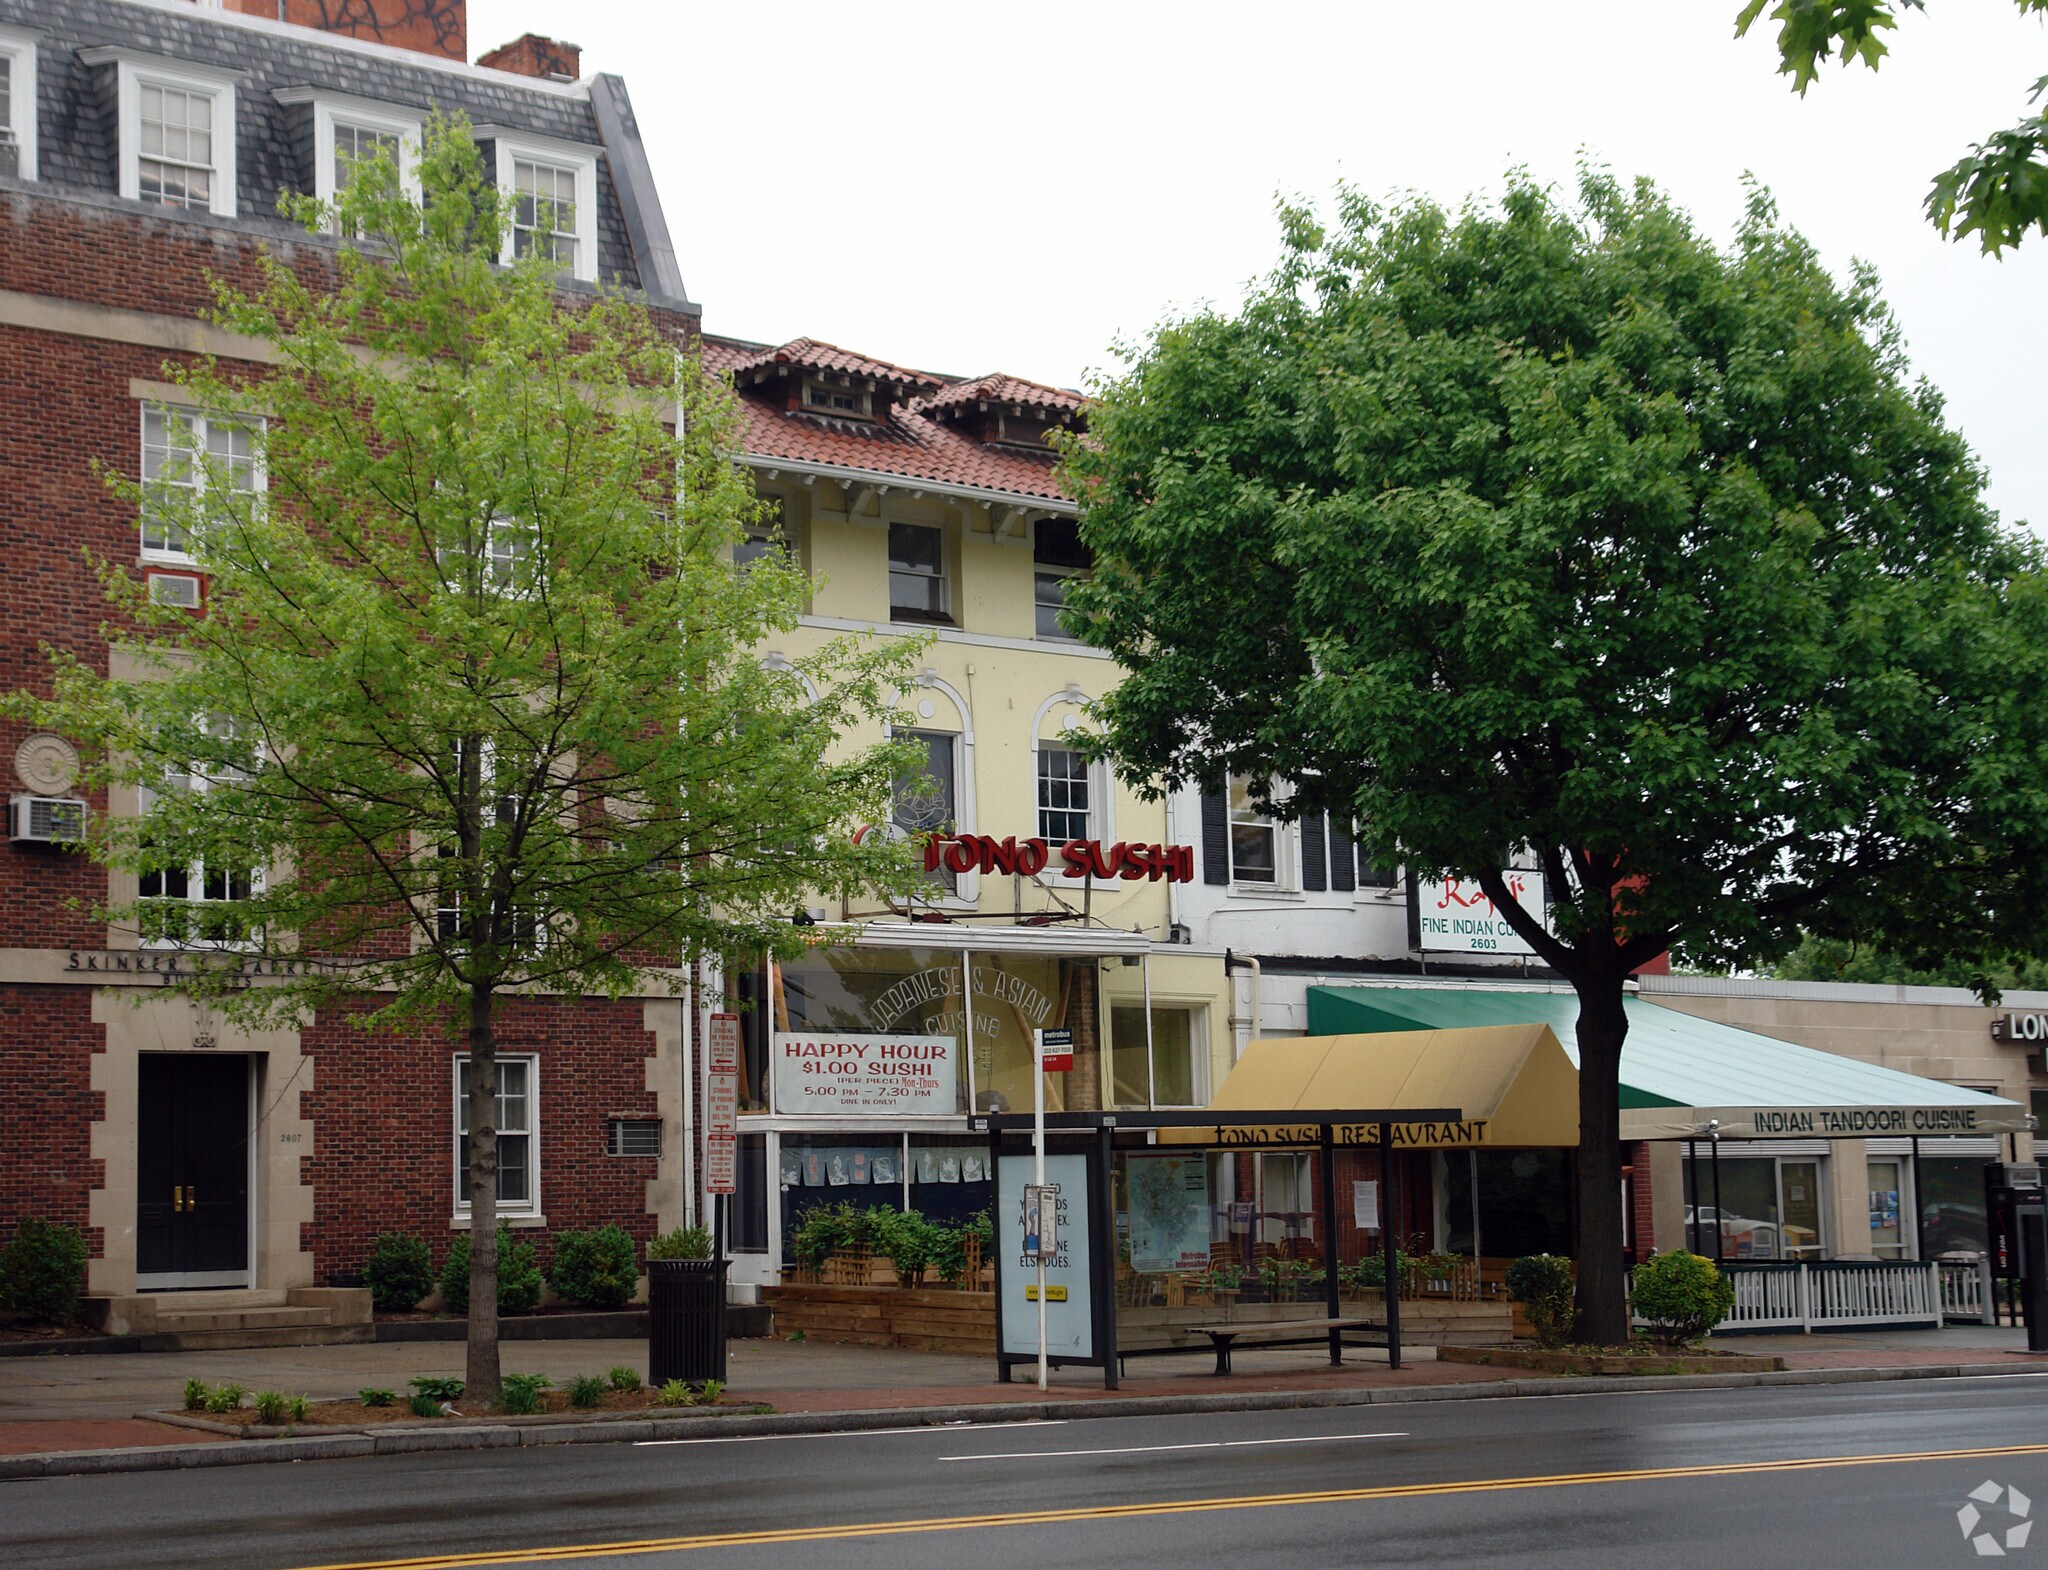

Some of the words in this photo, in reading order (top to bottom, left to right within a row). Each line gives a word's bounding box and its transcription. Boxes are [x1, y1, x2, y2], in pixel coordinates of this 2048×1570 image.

[912, 833, 1048, 877] TONO
[1061, 839, 1194, 884] SUSHI
[1422, 917, 1449, 933] FINE
[1453, 919, 1493, 935] INDIAN
[1471, 938, 1497, 949] 2603
[69, 952, 177, 971] SKINKER
[870, 967, 962, 1033] JAPANESE
[973, 967, 984, 994] &
[994, 971, 1052, 1024] ASIAN
[924, 1011, 1000, 1038] CUISNE
[1044, 1030, 1070, 1038] metrobus
[785, 1043, 870, 1058] HAPPY
[881, 1044, 947, 1060] HOUR
[802, 1061, 858, 1075] $1.00
[868, 1062, 932, 1076] SUSHI
[866, 1077, 899, 1085] PIECE)
[1754, 1112, 1814, 1132] INDIAN
[1820, 1110, 1907, 1131] TANDOORI
[1912, 1110, 1977, 1130] CUISINE
[1340, 1121, 1488, 1145] RESAURANT
[1999, 1234, 2008, 1268] verizon
